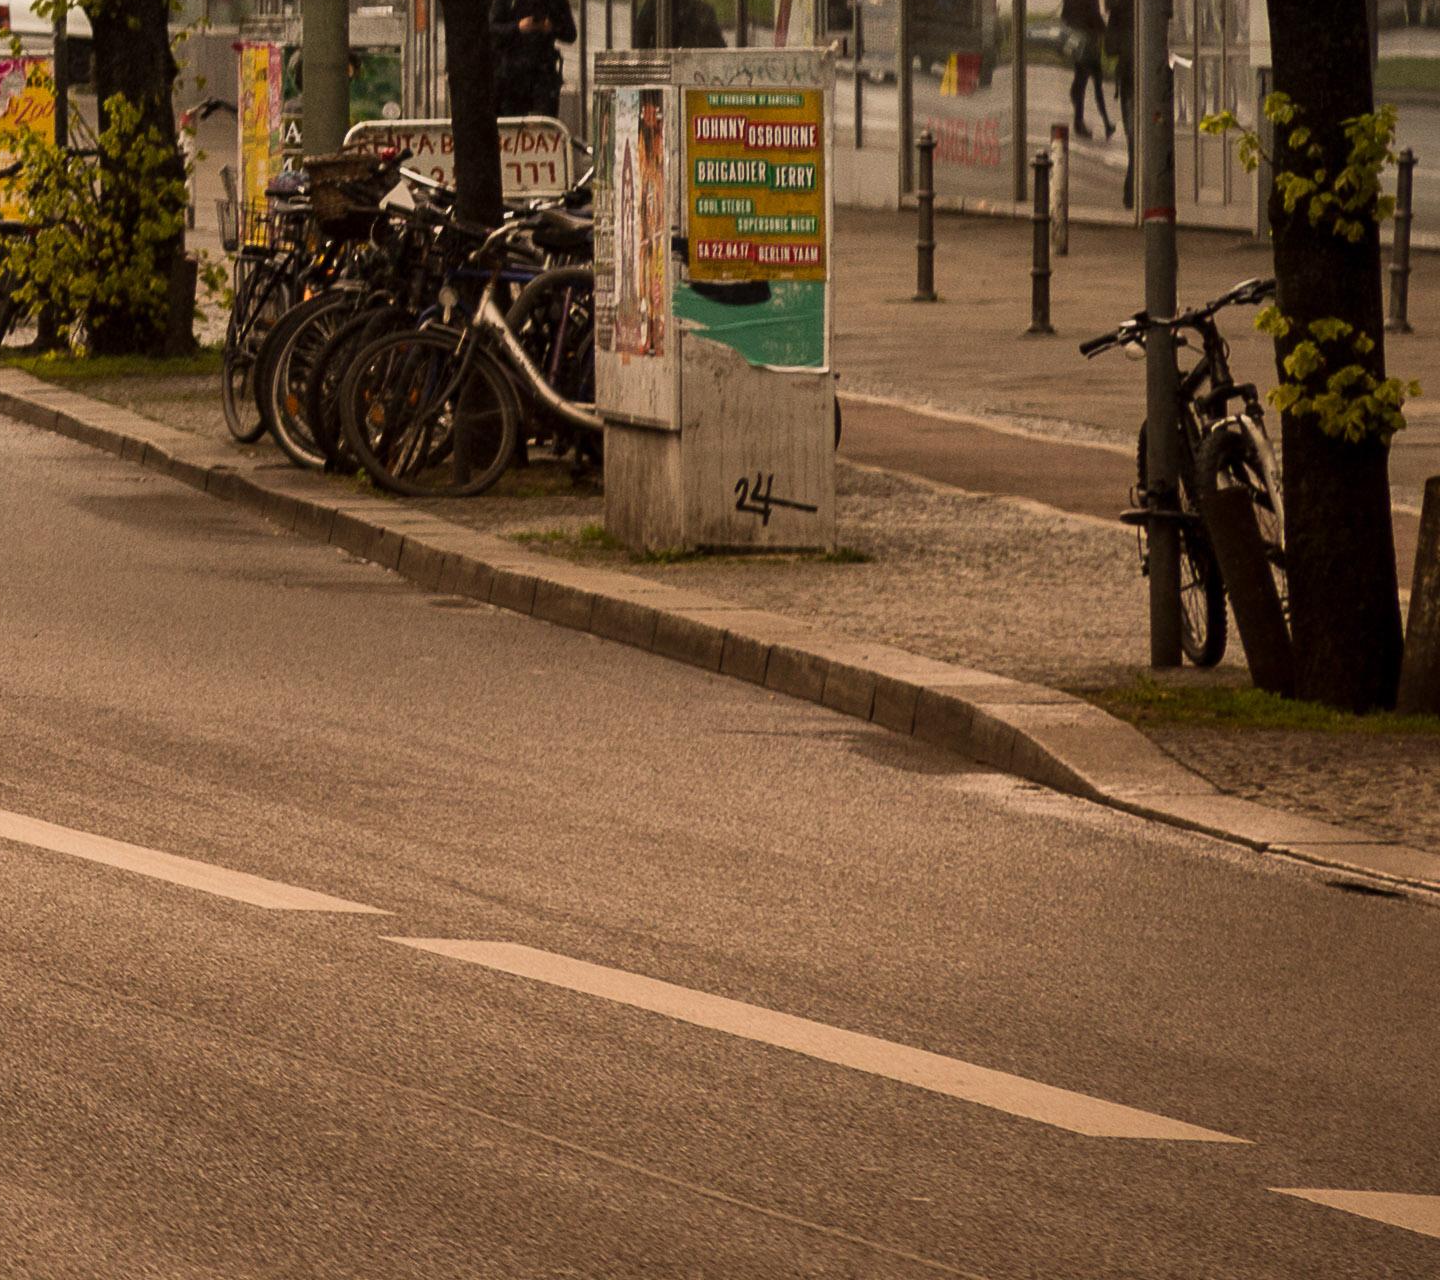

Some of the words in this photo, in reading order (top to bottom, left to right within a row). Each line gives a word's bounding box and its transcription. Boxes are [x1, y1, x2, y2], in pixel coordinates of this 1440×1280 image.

[697, 118, 745, 139] JOHNNY
[748, 125, 817, 147] OSBOURNE
[698, 161, 767, 183] BRIGADIER
[776, 167, 815, 189] JERRY
[721, 200, 751, 214] STEREO
[737, 217, 789, 232] SUPERSONIC
[791, 217, 816, 232] NIGHT
[698, 243, 710, 258] SA
[758, 247, 790, 262] BERLIN
[793, 247, 819, 262] YAAM
